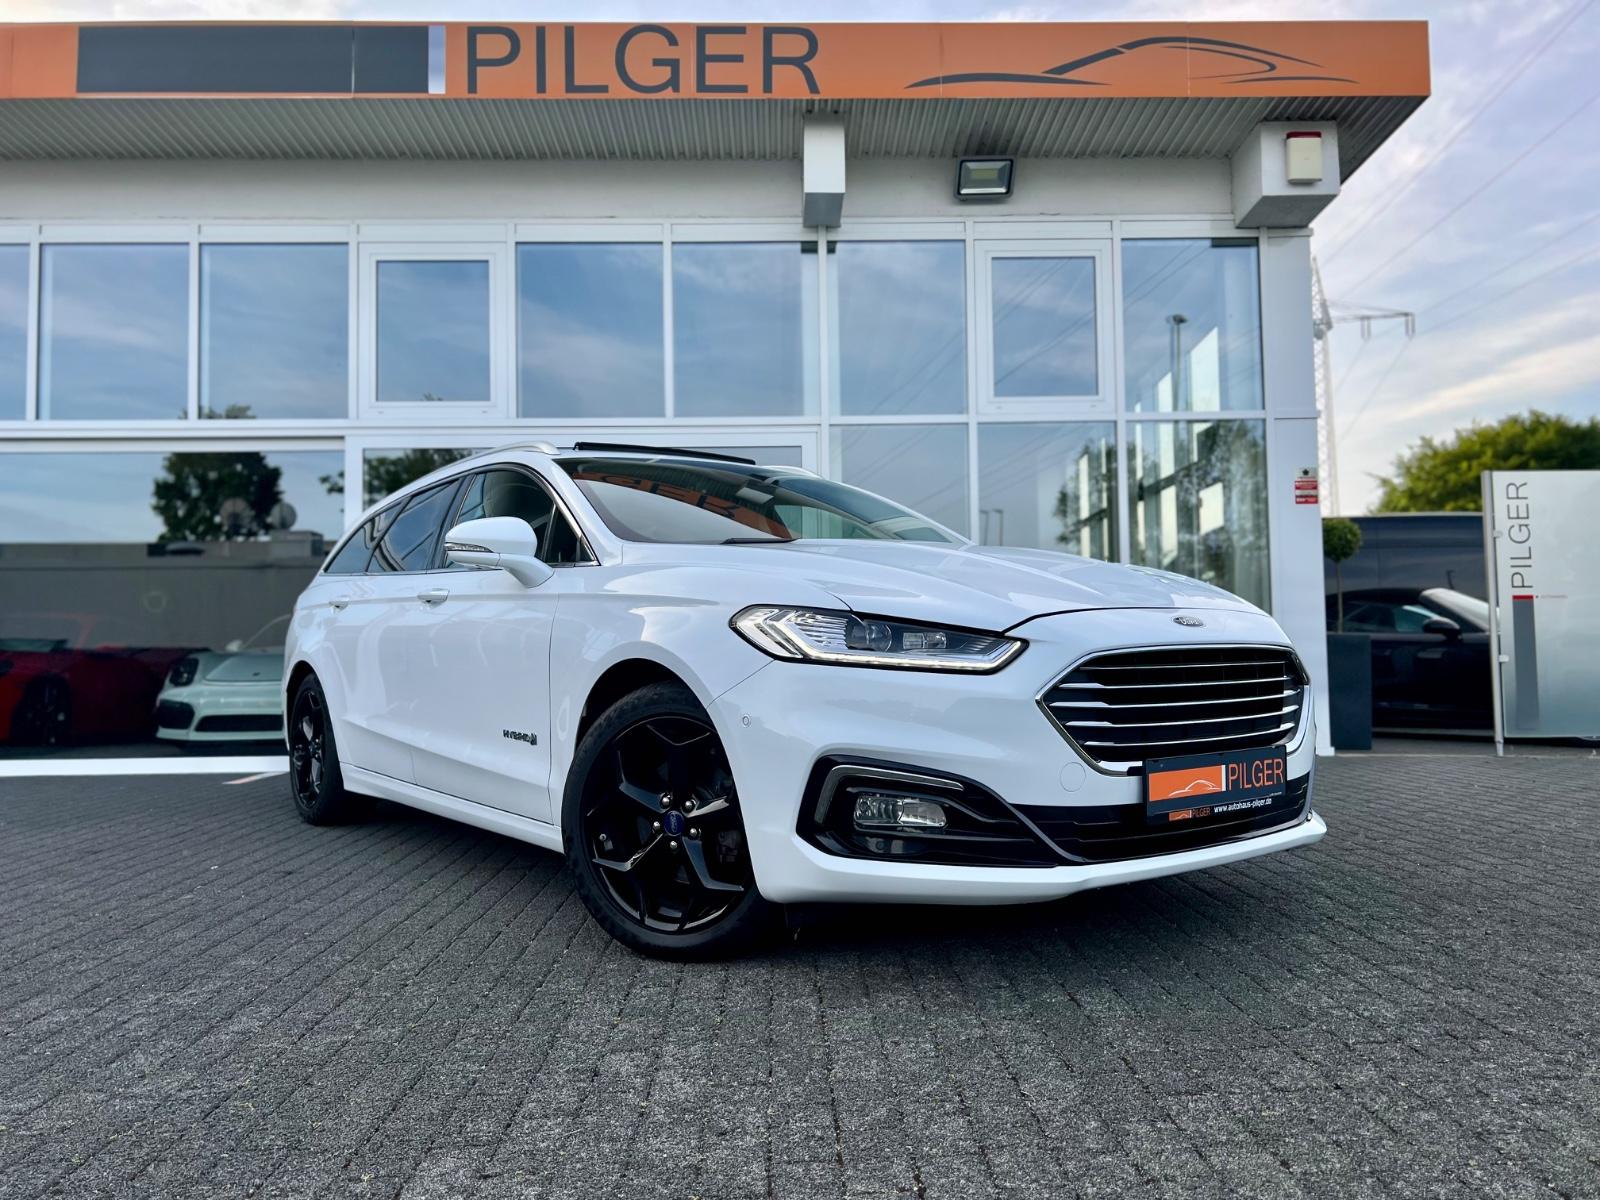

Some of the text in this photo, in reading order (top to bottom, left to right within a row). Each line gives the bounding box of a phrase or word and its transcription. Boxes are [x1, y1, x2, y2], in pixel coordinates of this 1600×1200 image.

[467, 25, 820, 94] PILGER
[1506, 482, 1533, 588] PILGER
[1228, 758, 1284, 791] PILGER
[1214, 797, 1272, 813] www.autohaus-pilger.de
